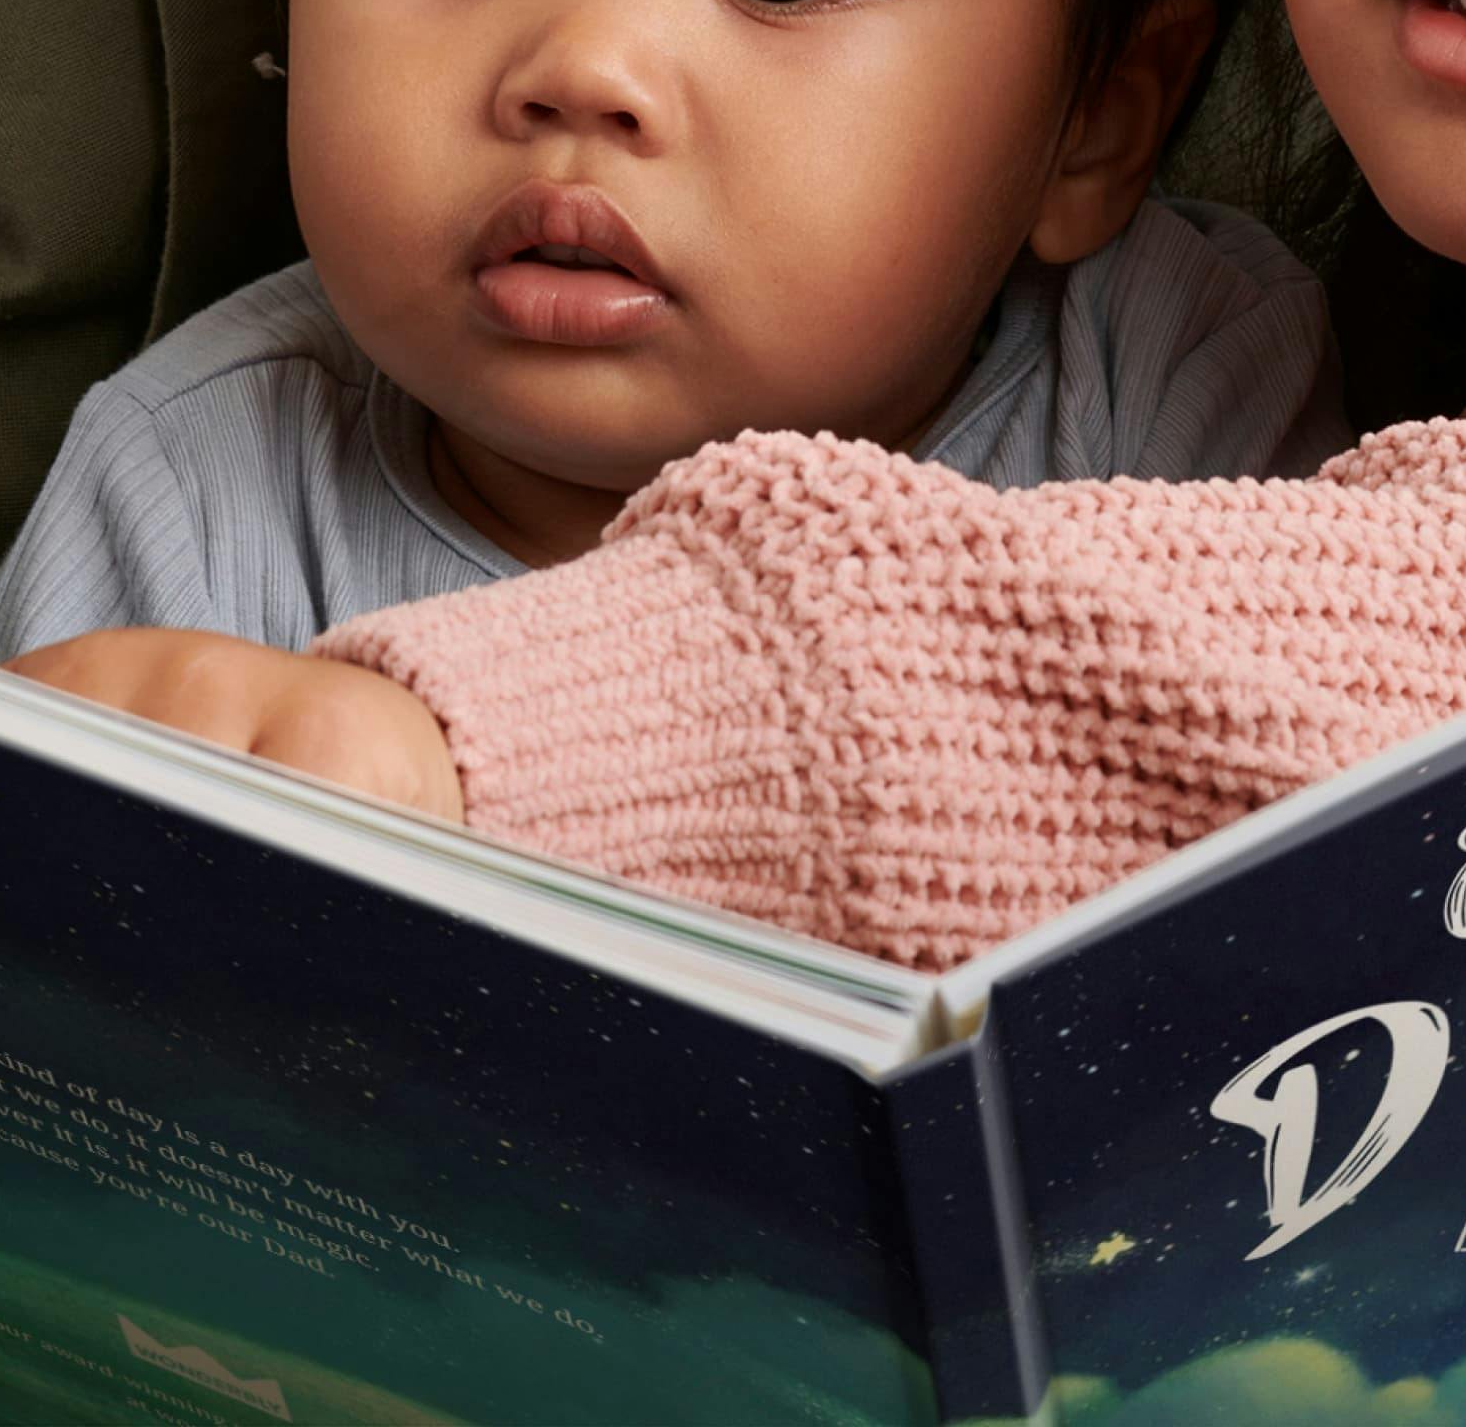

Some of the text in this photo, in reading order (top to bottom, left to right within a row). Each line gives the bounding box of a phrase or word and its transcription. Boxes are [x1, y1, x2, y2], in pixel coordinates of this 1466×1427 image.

[13, 1085, 61, 1115] we
[126, 1127, 151, 1152] it
[158, 1145, 274, 1204] doesn't
[284, 1196, 393, 1252] matter
[399, 1244, 487, 1291] what
[493, 1282, 544, 1315] we
[52, 1121, 79, 1147] it
[125, 1152, 151, 1177] it
[156, 1168, 220, 1206] will
[225, 1193, 266, 1225] be
[273, 1217, 380, 1273] magic.
[66, 1082, 101, 1105] of
[106, 1096, 163, 1133] day
[172, 1121, 200, 1146] is
[209, 1140, 229, 1158] a
[236, 1149, 296, 1188] day
[302, 1178, 380, 1221] with
[388, 1213, 461, 1253] you.
[87, 1164, 189, 1217] you're
[197, 1211, 254, 1244] our
[261, 1233, 336, 1279] Dad.
